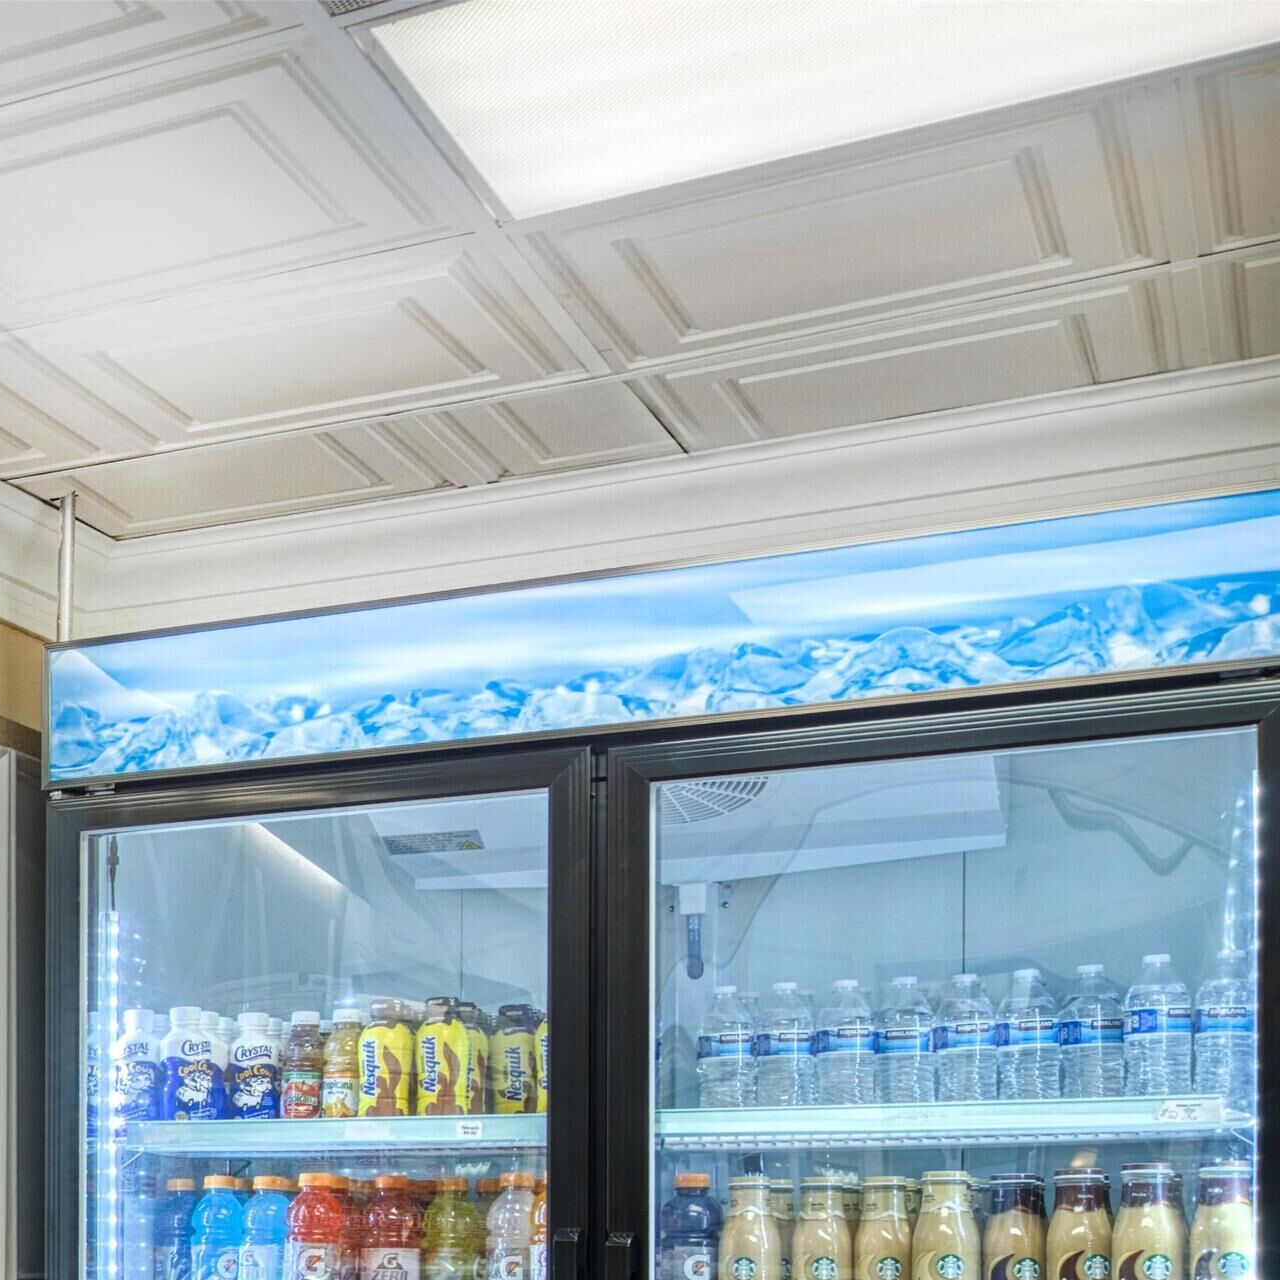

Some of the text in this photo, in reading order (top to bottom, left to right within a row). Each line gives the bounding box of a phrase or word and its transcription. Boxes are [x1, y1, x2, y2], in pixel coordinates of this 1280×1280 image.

[235, 1044, 273, 1062] CRYSTAL
[363, 1040, 379, 1096] Nesquik
[423, 1036, 440, 1092] Nesquik
[507, 1047, 523, 1101] Nesquik
